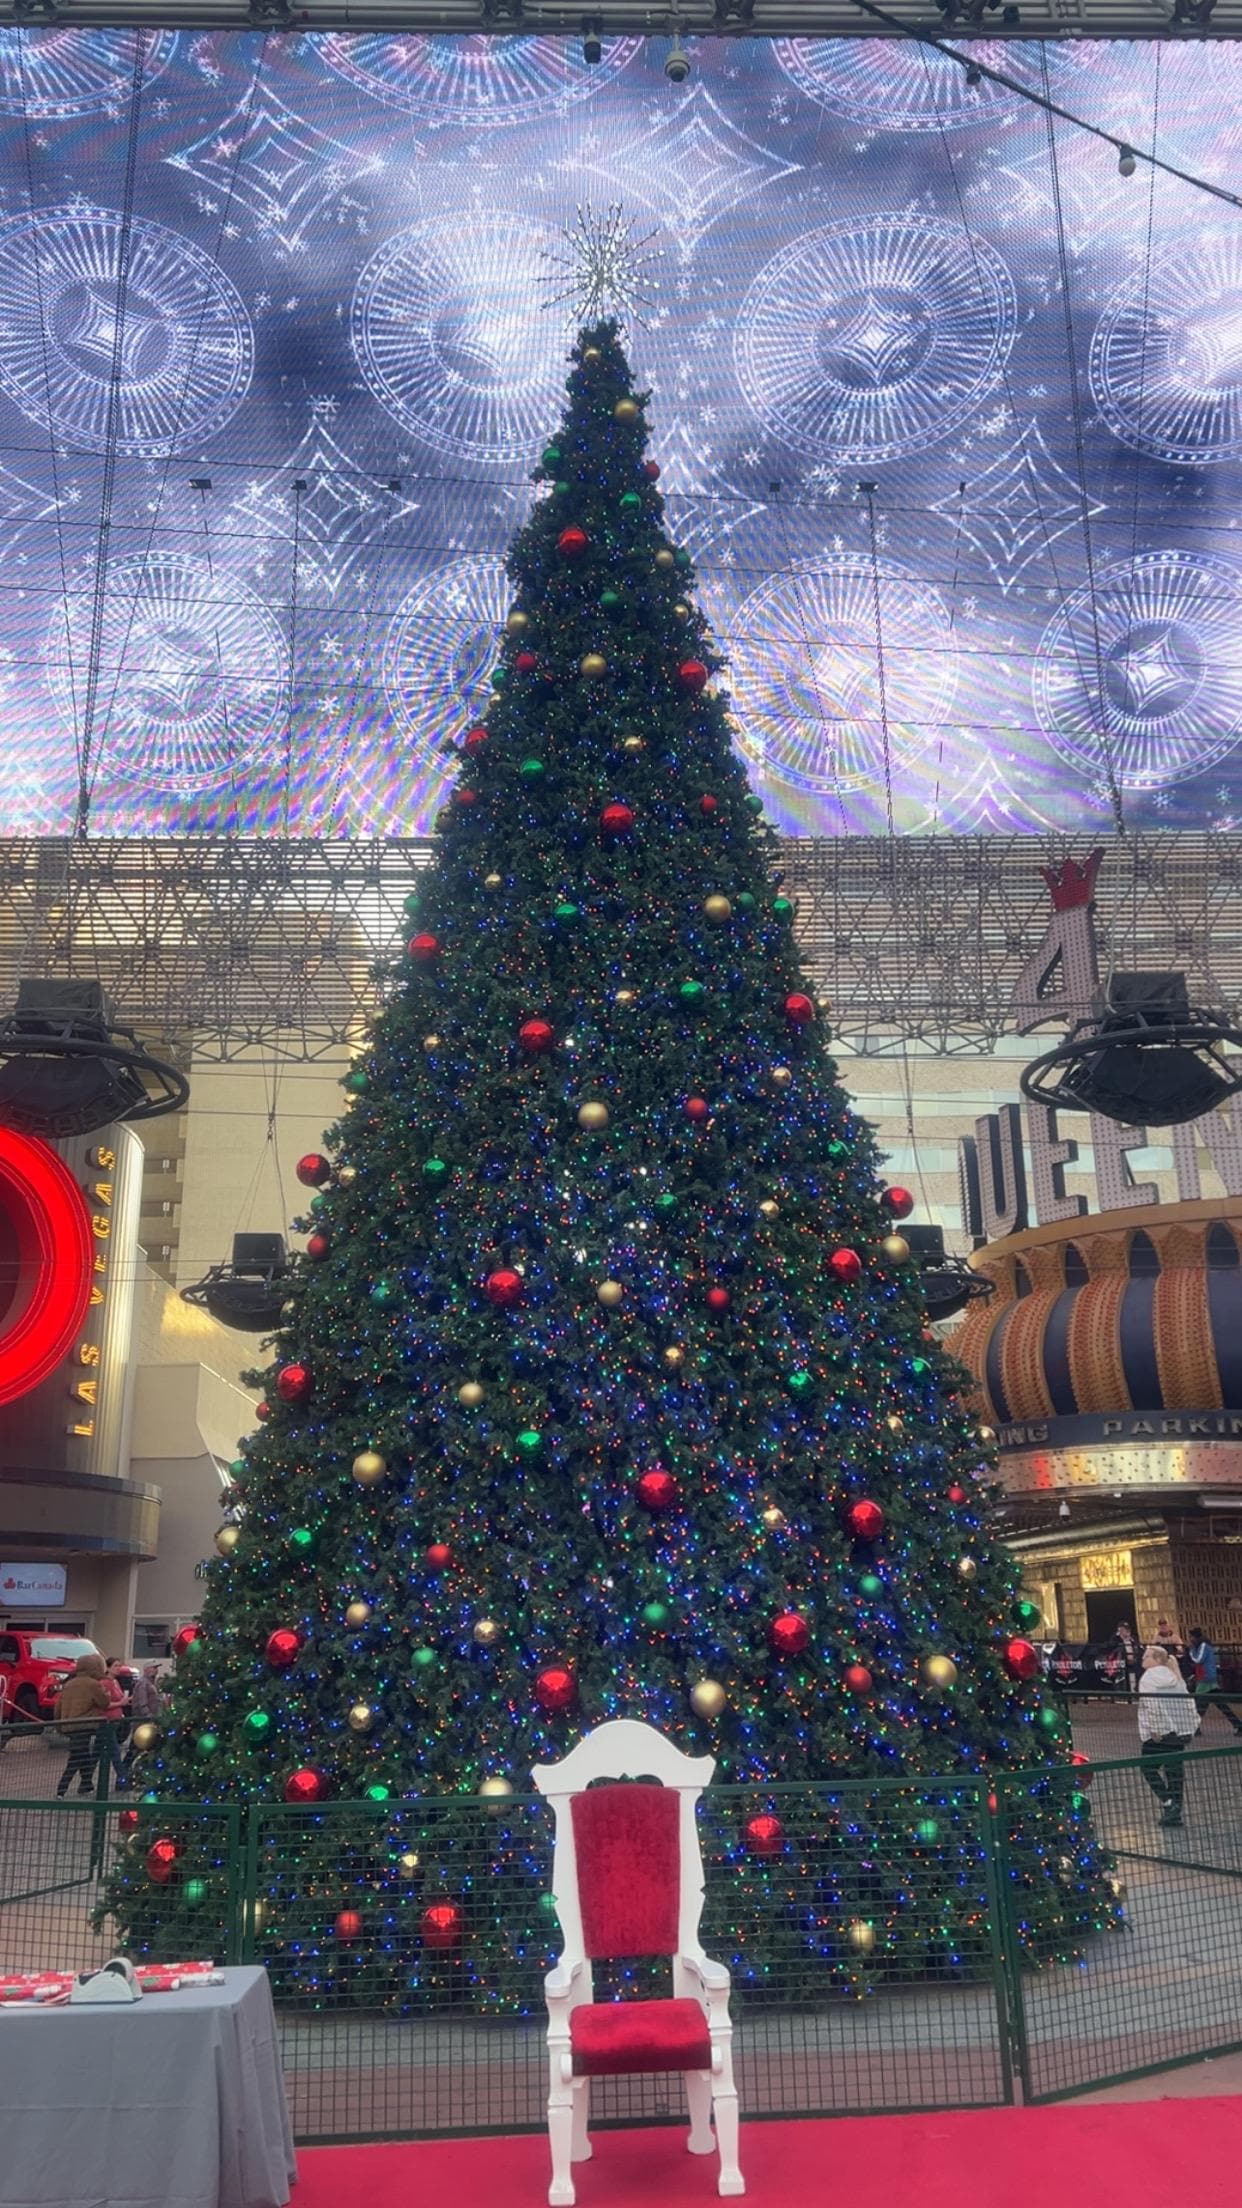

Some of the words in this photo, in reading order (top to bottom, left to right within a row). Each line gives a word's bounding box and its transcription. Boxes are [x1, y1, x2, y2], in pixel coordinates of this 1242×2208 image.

[957, 1055, 1242, 1240] UEEN
[72, 1342, 99, 1437] LAS
[88, 1146, 115, 1306] VEGAS
[999, 1424, 1048, 1446] ING
